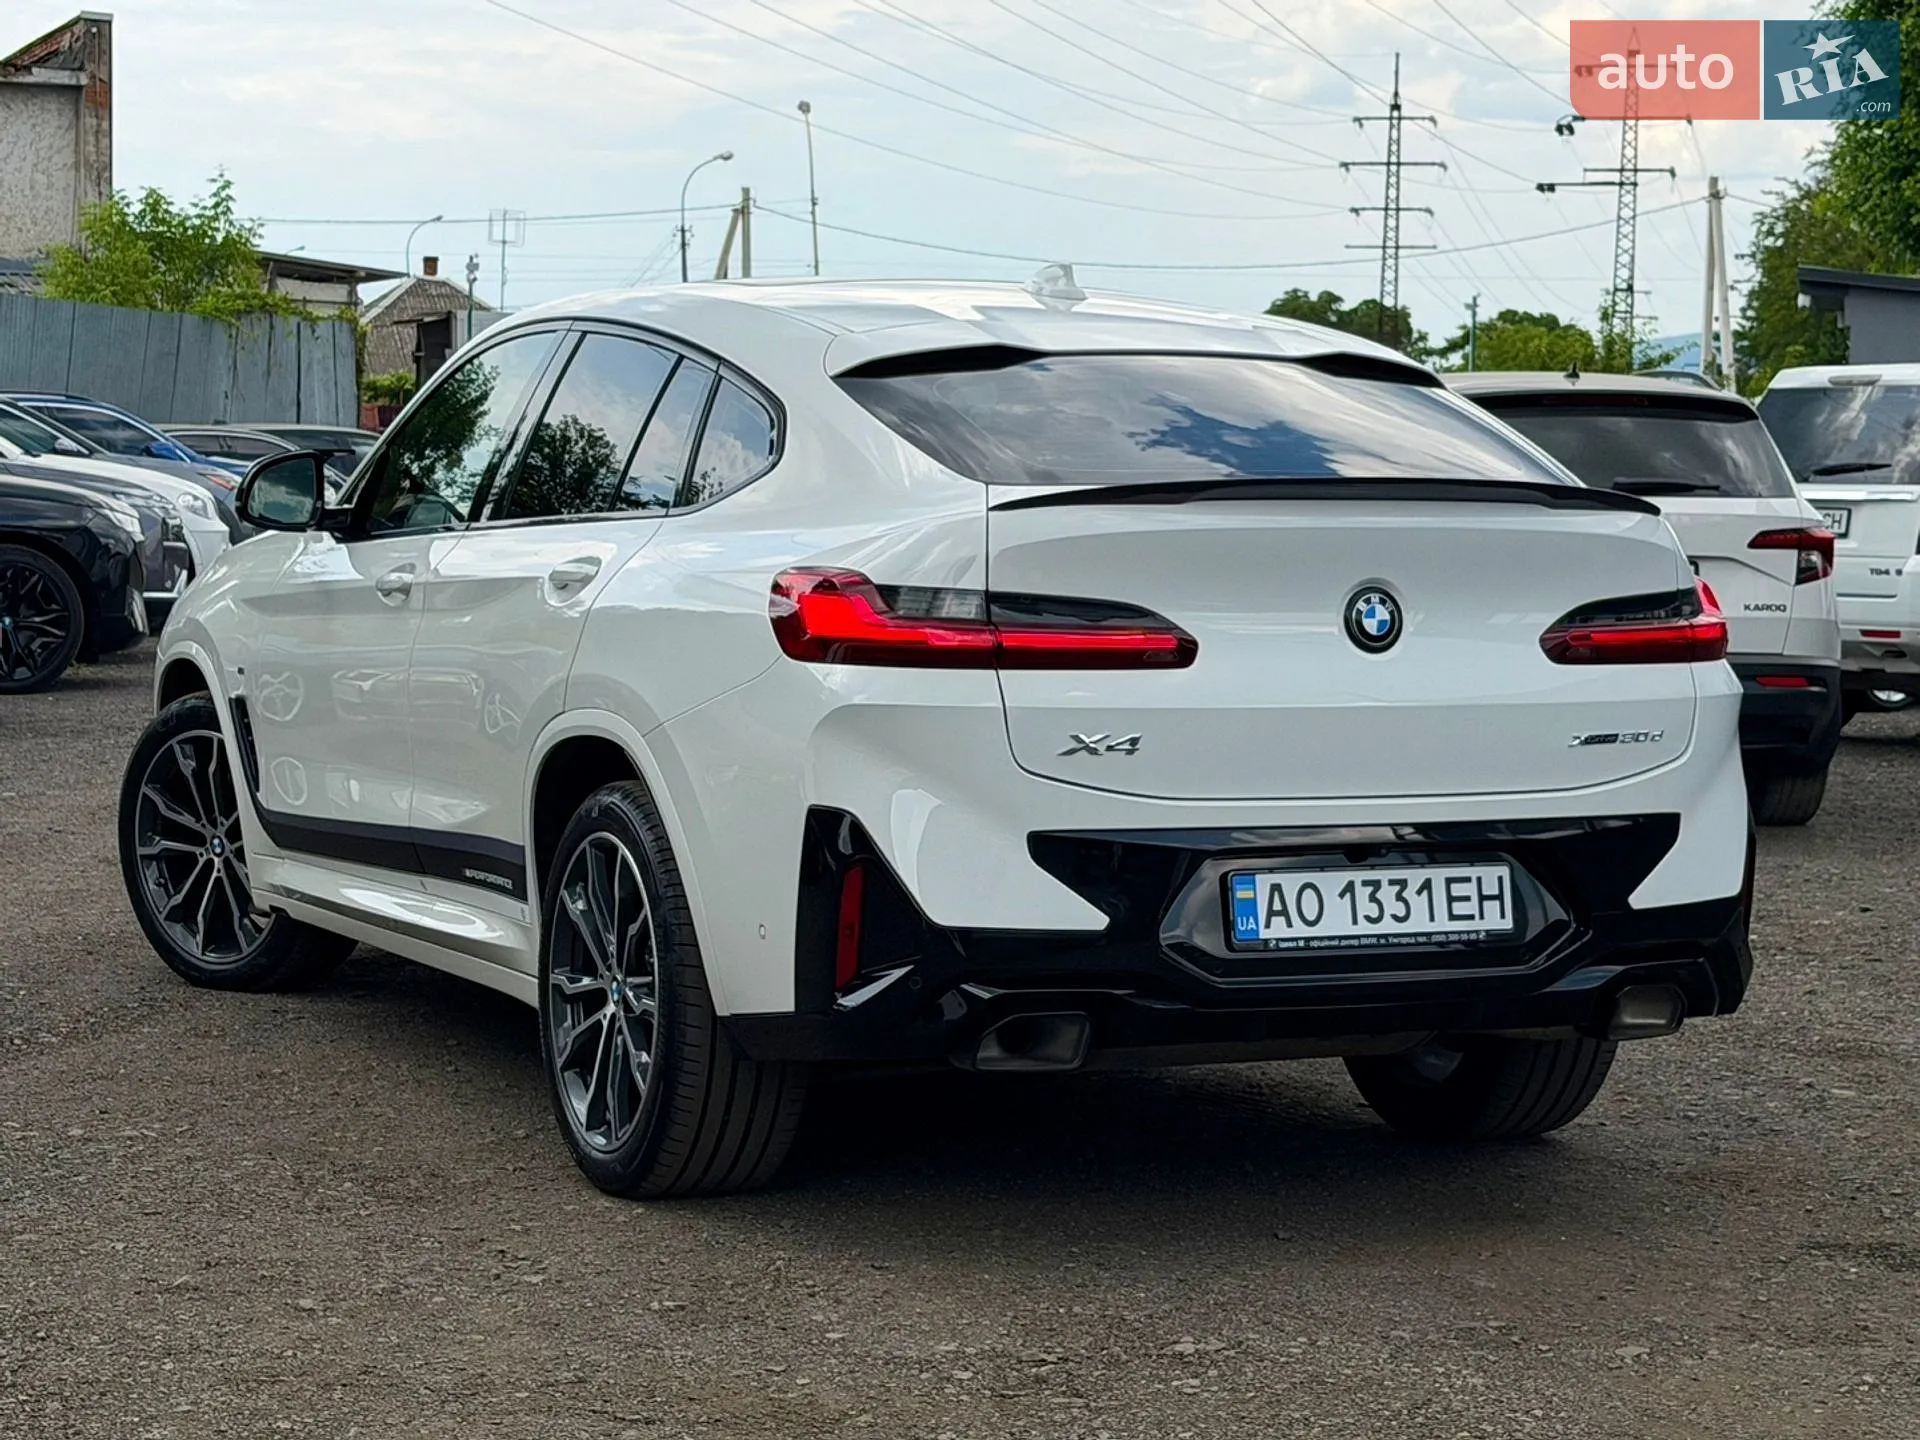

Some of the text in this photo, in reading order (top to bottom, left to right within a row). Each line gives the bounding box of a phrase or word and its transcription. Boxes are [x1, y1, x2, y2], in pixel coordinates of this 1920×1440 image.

[1356, 592, 1394, 612] BMW
[1743, 603, 1787, 613] KAROQ
[1056, 732, 1143, 757] X4
[1263, 874, 1507, 930] AO 1331 EH
[1238, 915, 1257, 931] UA
